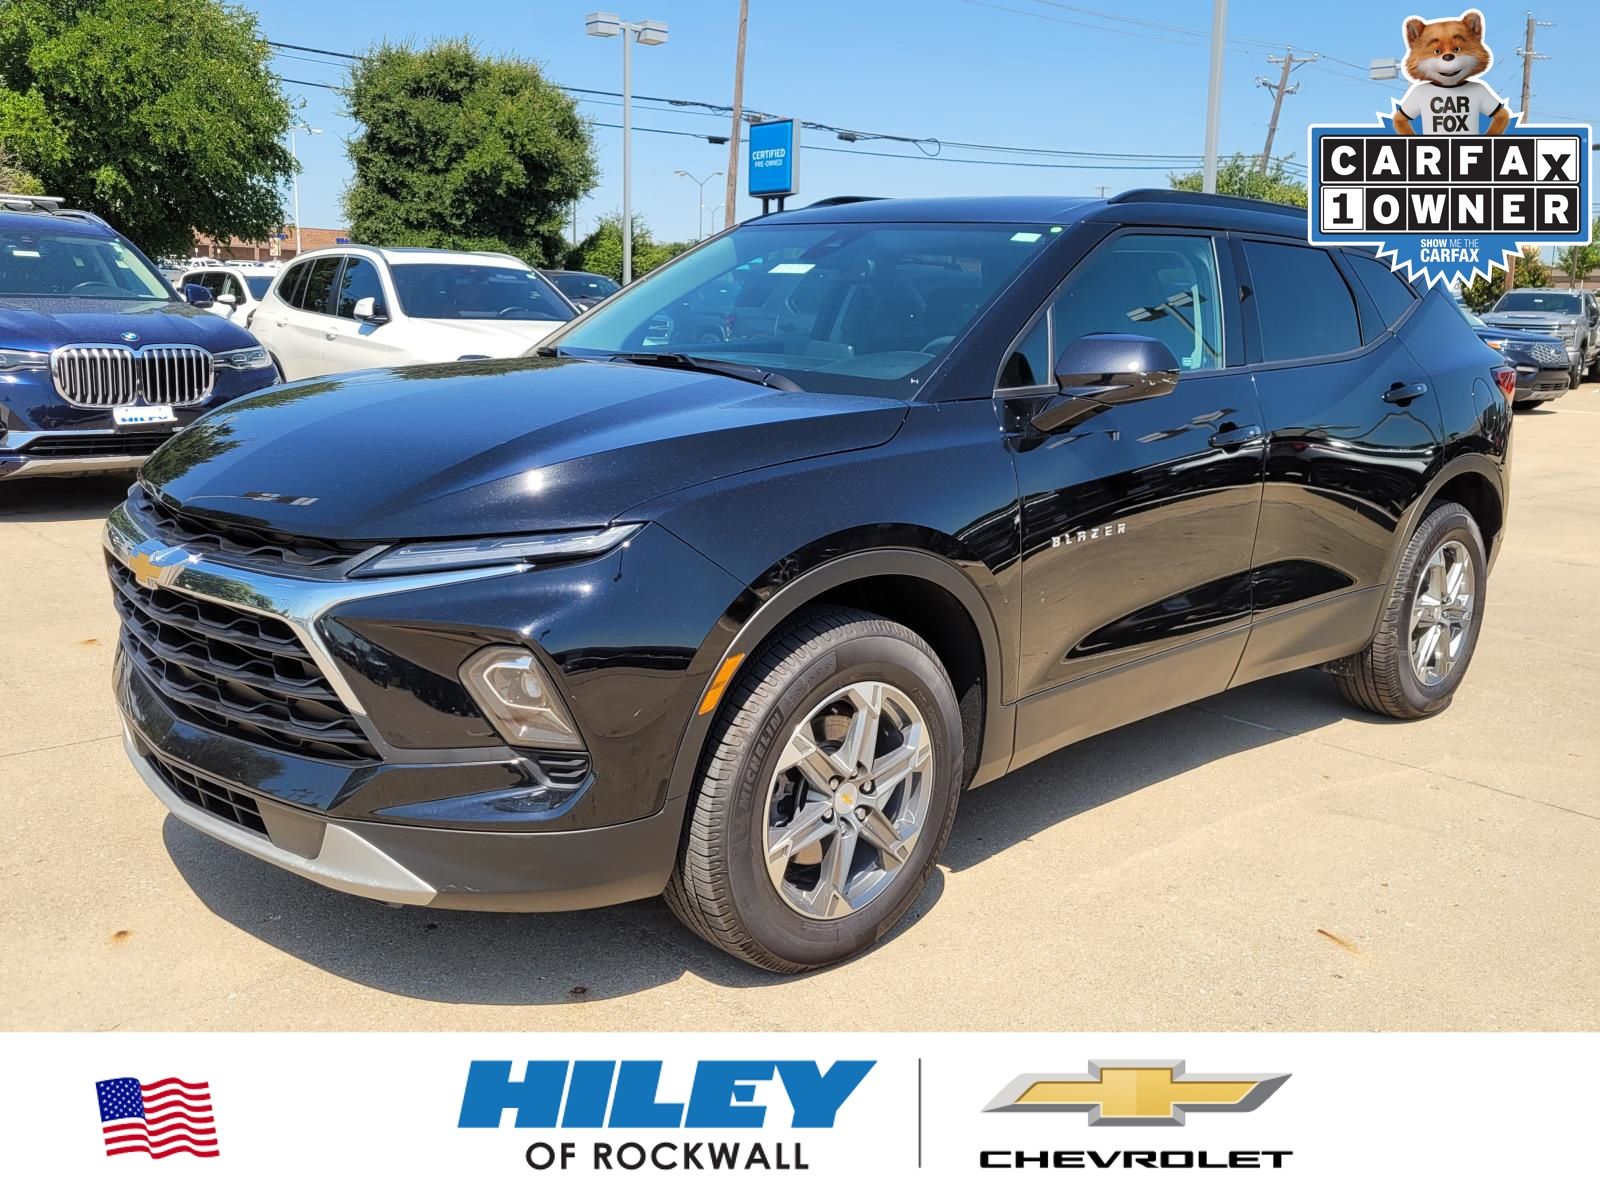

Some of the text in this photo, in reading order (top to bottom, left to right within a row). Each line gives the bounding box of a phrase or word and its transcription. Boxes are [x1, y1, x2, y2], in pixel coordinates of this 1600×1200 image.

[752, 148, 785, 160] CERTIFIED
[754, 159, 782, 168] PRE-OWNED
[1051, 523, 1126, 548] BLAZER
[738, 708, 784, 812] MICHELIN
